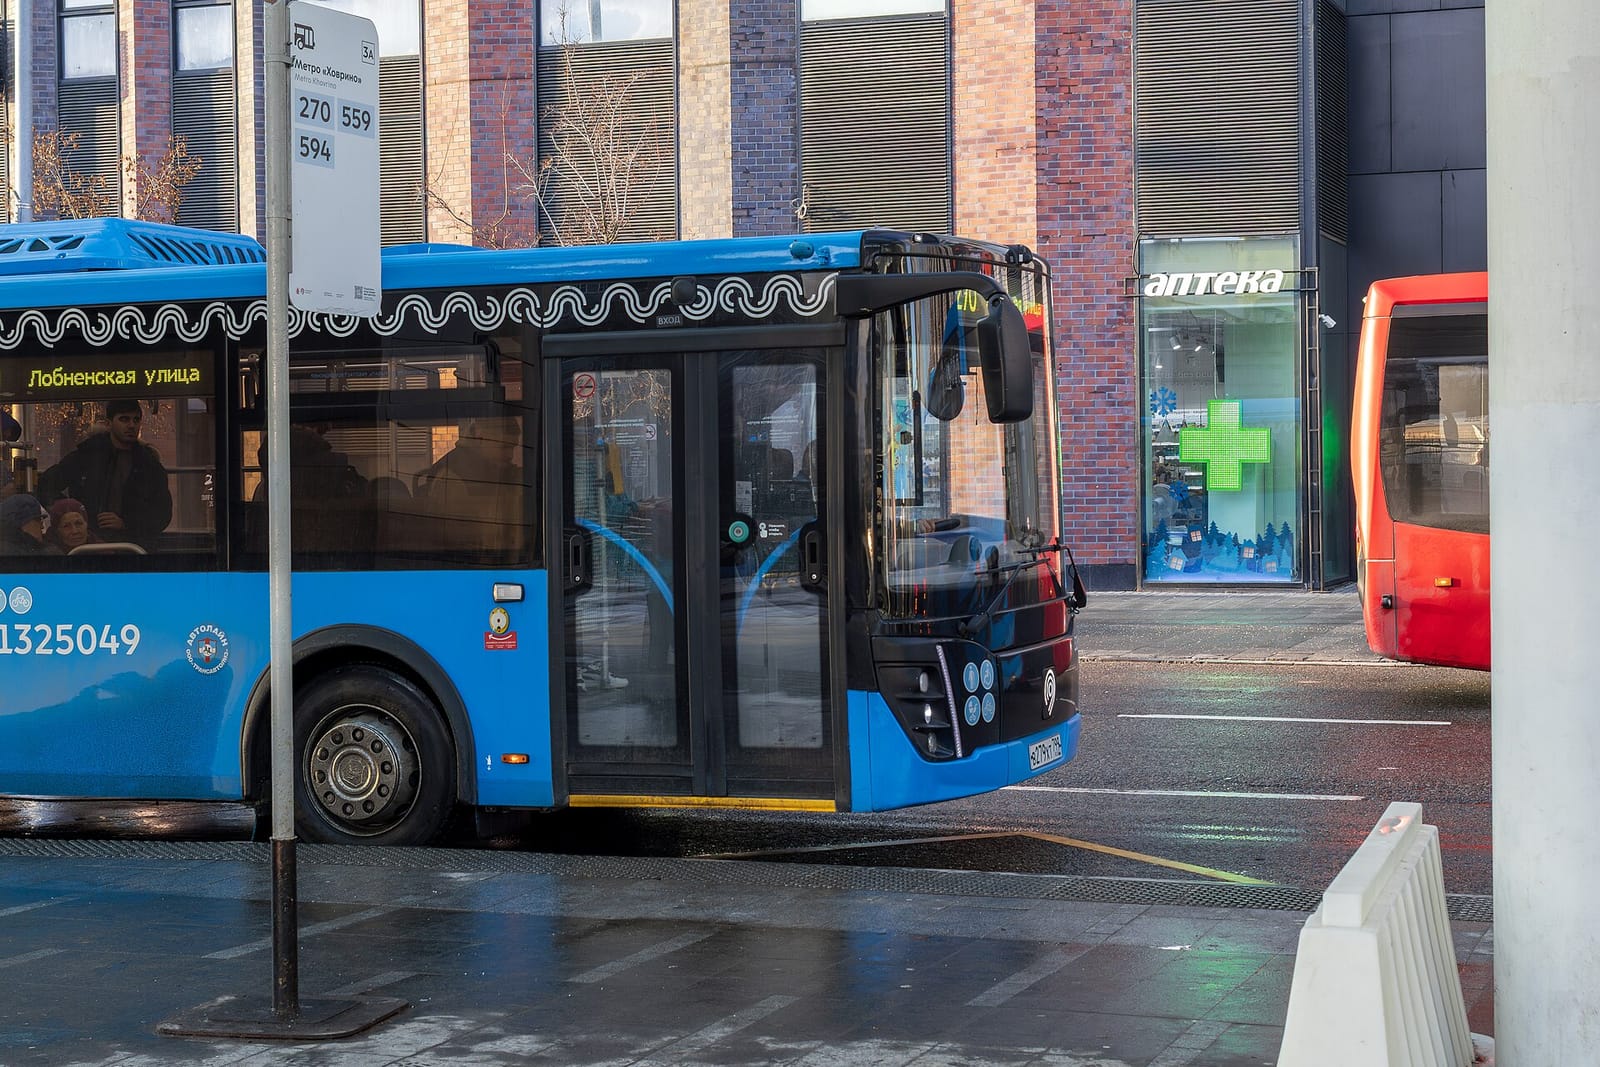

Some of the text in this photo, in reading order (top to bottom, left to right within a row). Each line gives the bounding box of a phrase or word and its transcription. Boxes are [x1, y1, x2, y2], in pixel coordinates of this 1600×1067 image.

[294, 58, 362, 84] Метро «Ховрино»
[294, 73, 312, 84] Metro
[299, 96, 331, 123] 270
[342, 105, 371, 131] 559
[300, 135, 331, 162] 594
[1144, 269, 1284, 297] аптека
[658, 316, 681, 325] ВХОД
[28, 367, 200, 388] Лобненская улица
[0, 624, 141, 655] 1325049
[186, 624, 228, 647] АВТОЛАЙН
